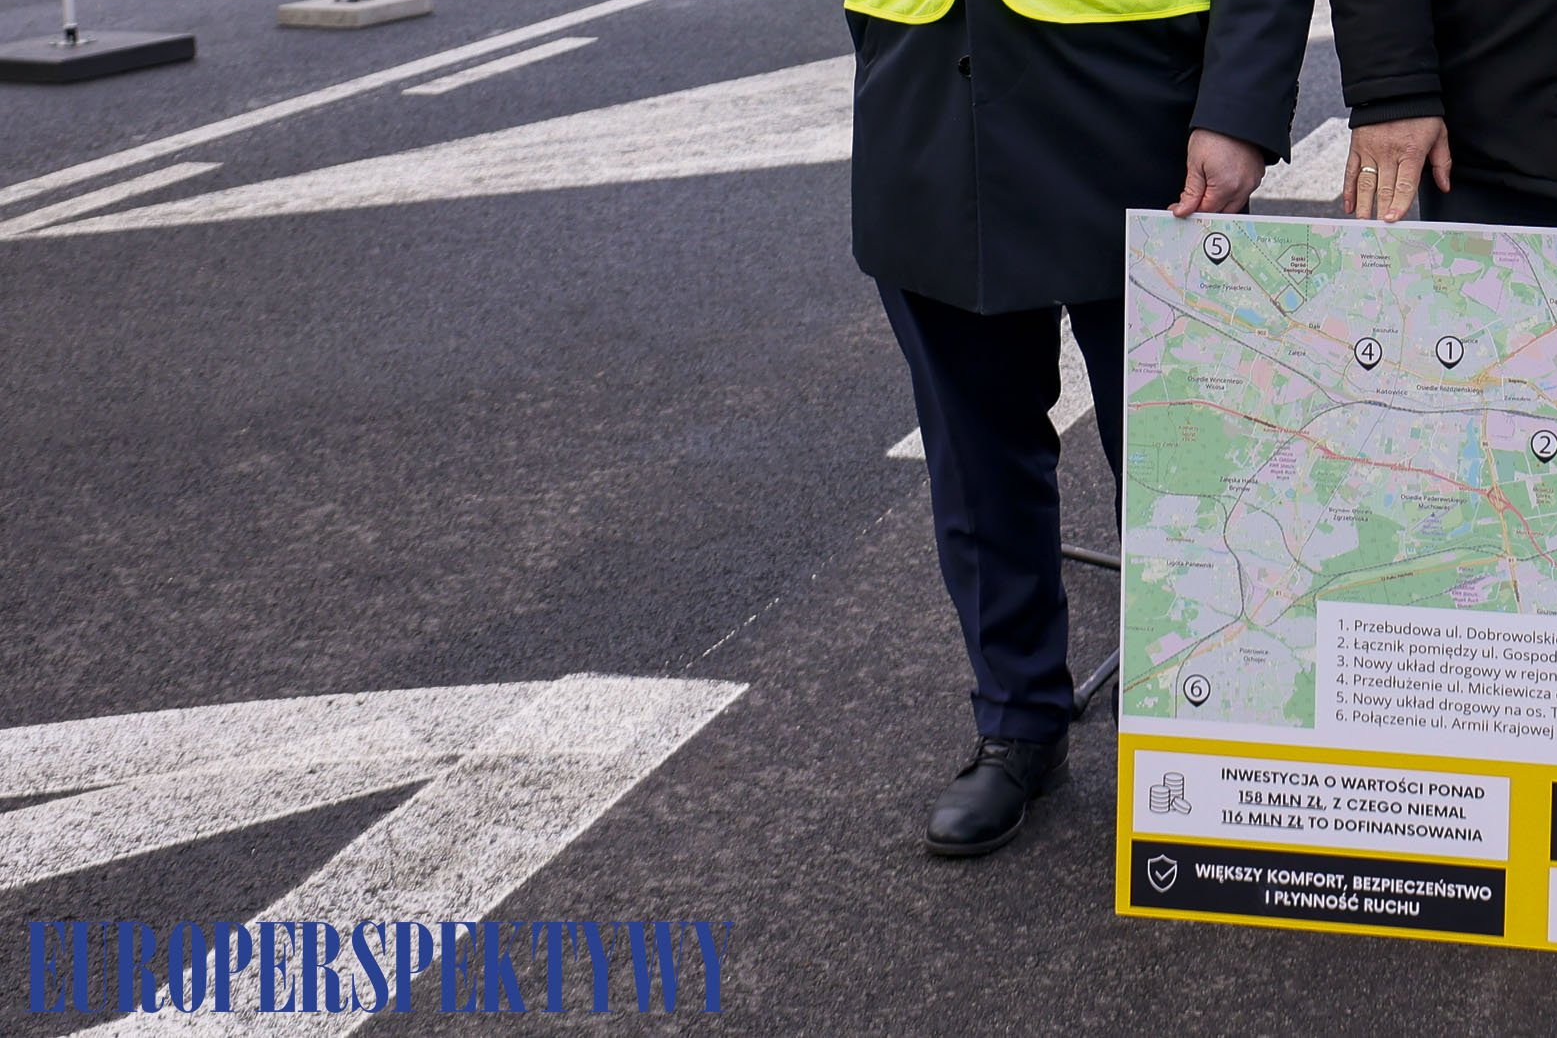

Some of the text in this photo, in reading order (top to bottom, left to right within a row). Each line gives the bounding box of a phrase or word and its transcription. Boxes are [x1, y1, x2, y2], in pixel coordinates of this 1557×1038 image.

[1211, 237, 1223, 256] 5
[1361, 342, 1375, 361] 4
[1446, 341, 1453, 360] 1
[1539, 436, 1552, 455] 2
[1339, 619, 1349, 631] 1.
[1355, 620, 1441, 637] Przebudowa
[1446, 625, 1462, 639] ul.
[1337, 636, 1349, 649] 2.
[1354, 637, 1404, 654] Łącznik
[1409, 643, 1478, 661] pomiędzy
[1482, 646, 1498, 659] ul.
[1337, 655, 1348, 667] 3.
[1354, 656, 1393, 673] Nowy
[1397, 658, 1435, 673] układ
[1440, 661, 1501, 681] drogowy
[1505, 669, 1517, 679] w
[1190, 679, 1203, 698] 6
[1336, 673, 1348, 685] 4.
[1353, 674, 1442, 692] Przedłużenie
[1447, 680, 1463, 693] ul.
[1468, 682, 1551, 699] Mickiewicza
[1336, 691, 1348, 704] 5.
[1353, 692, 1392, 710] Nowy
[1396, 695, 1434, 710] układ
[1439, 698, 1500, 718] drogowy
[1505, 706, 1521, 716] na
[1526, 707, 1546, 718] os.
[1336, 709, 1347, 722] 6.
[1353, 710, 1426, 727] Połączenie
[1431, 715, 1447, 729] ul.
[1451, 718, 1488, 732] Armii
[1494, 720, 1554, 740] Krajowej
[1222, 768, 1485, 799] INWESTYCJA O WARTOŚCI PONAD
[1238, 790, 1467, 820] 158 MLN ZŁ, Z CZEGO NIEMAL
[1220, 810, 1483, 843] 116 MLN ZŁ TO DOFINANSOWANIA
[1195, 862, 1493, 902] WIĘKSZY KOMFORT, BEZPIECZEŃSTWO
[1265, 890, 1421, 917] I PŁYNNOŚĆ RUCHU
